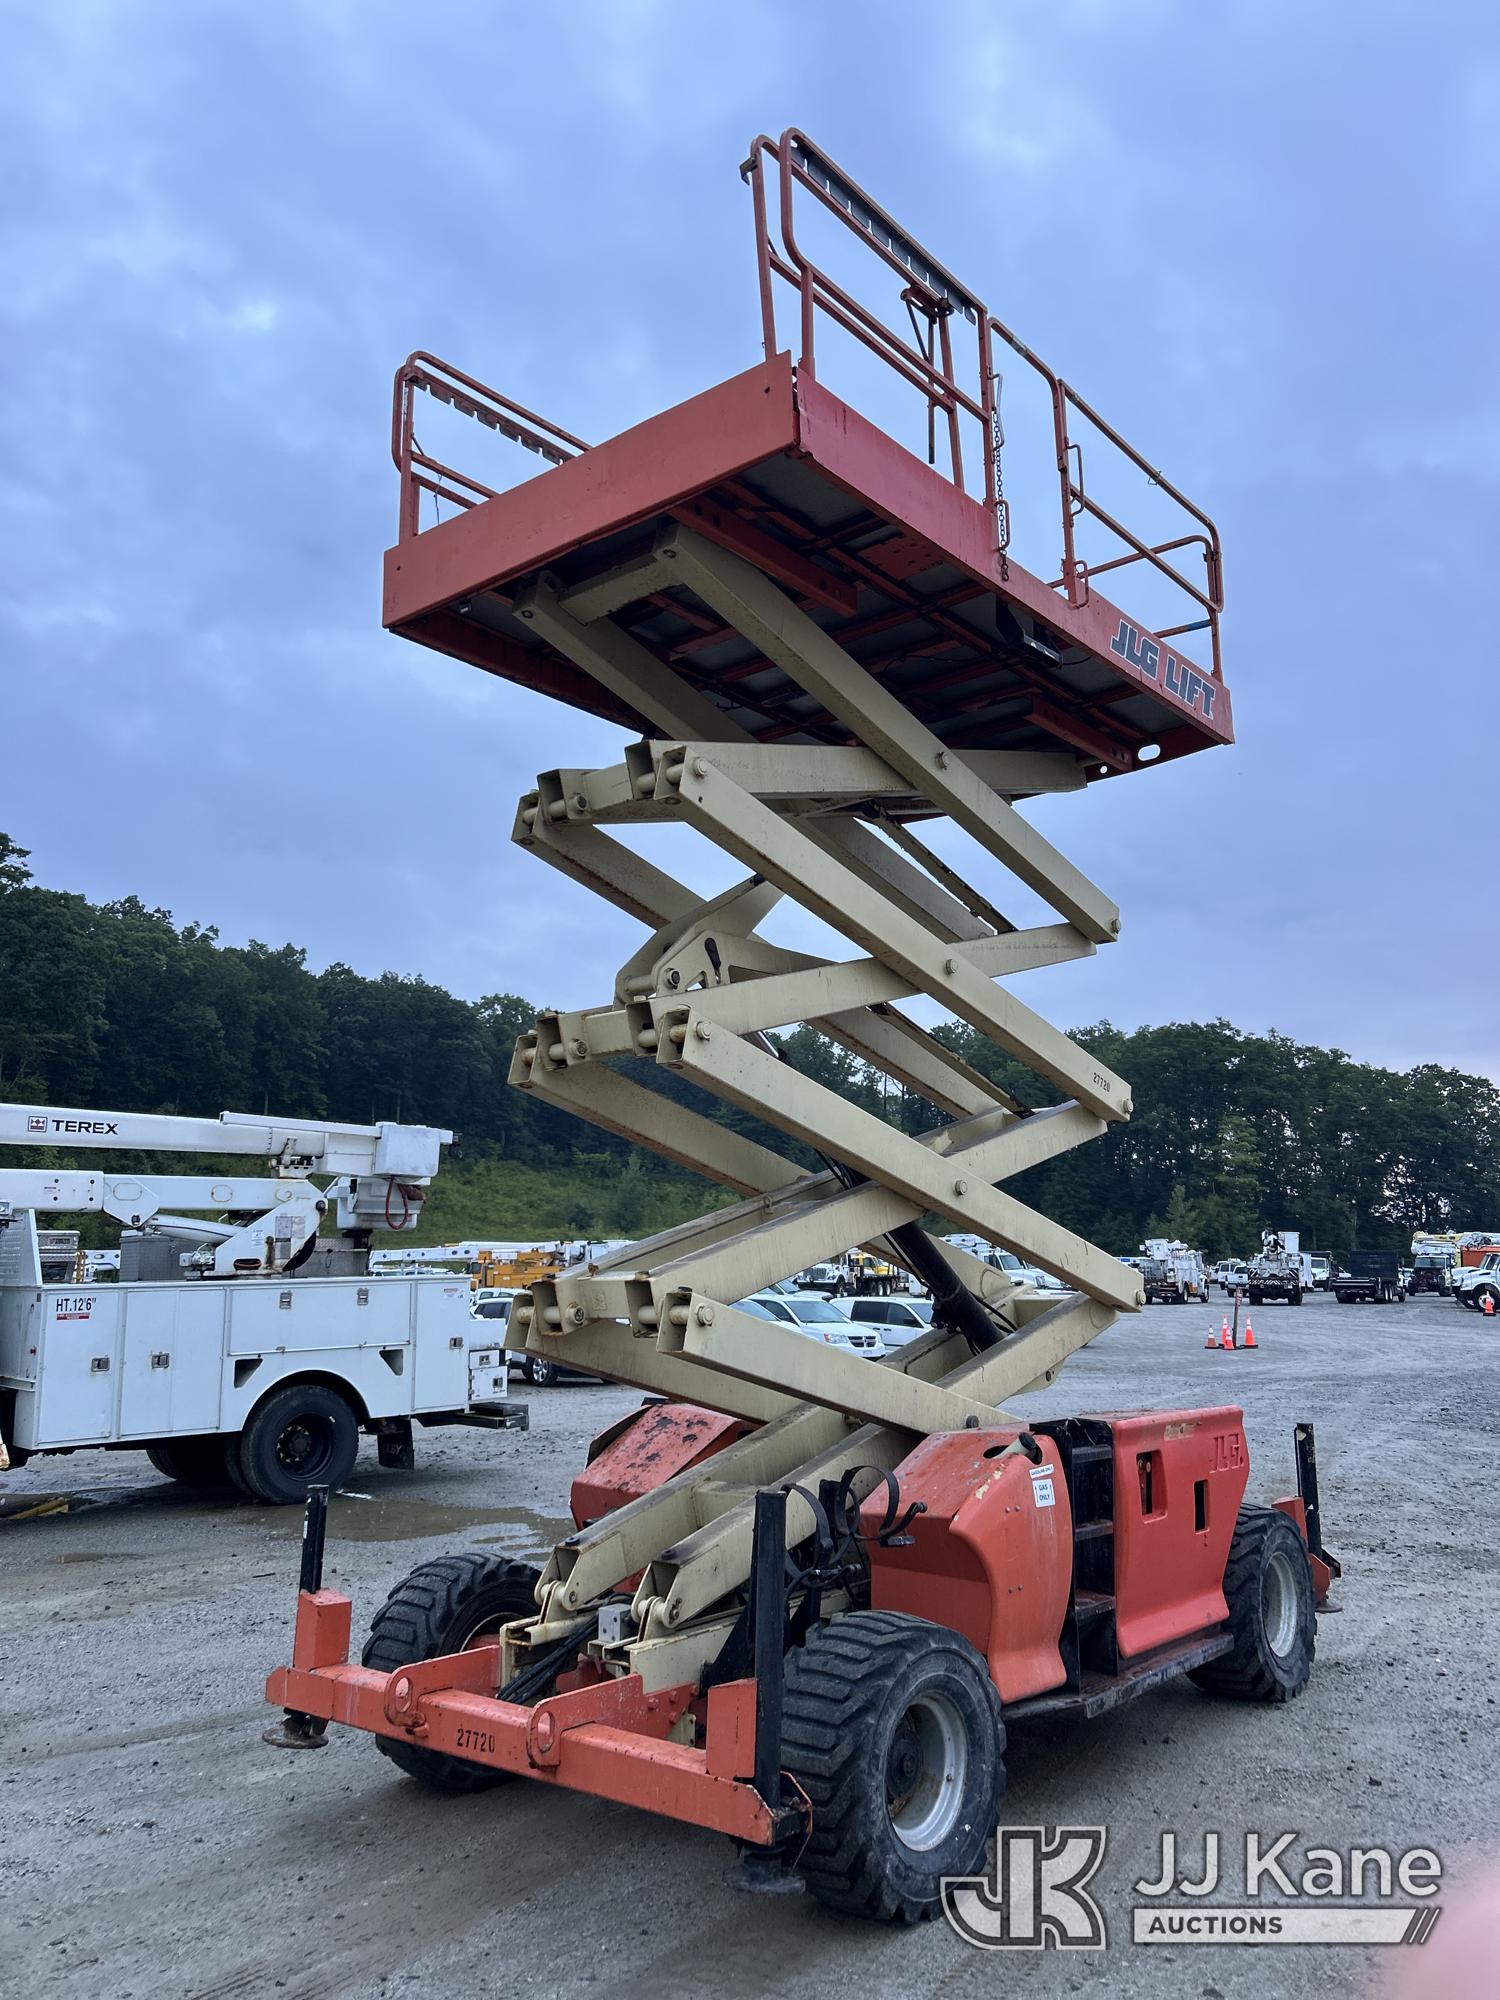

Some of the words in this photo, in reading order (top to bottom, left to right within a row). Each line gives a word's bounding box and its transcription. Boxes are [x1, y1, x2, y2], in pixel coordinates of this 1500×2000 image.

[1110, 619, 1160, 680] JLG
[1164, 654, 1216, 719] LIFT
[1093, 1072, 1111, 1092] 27720
[52, 1119, 118, 1135] TEREX
[456, 1728, 496, 1753] 27720
